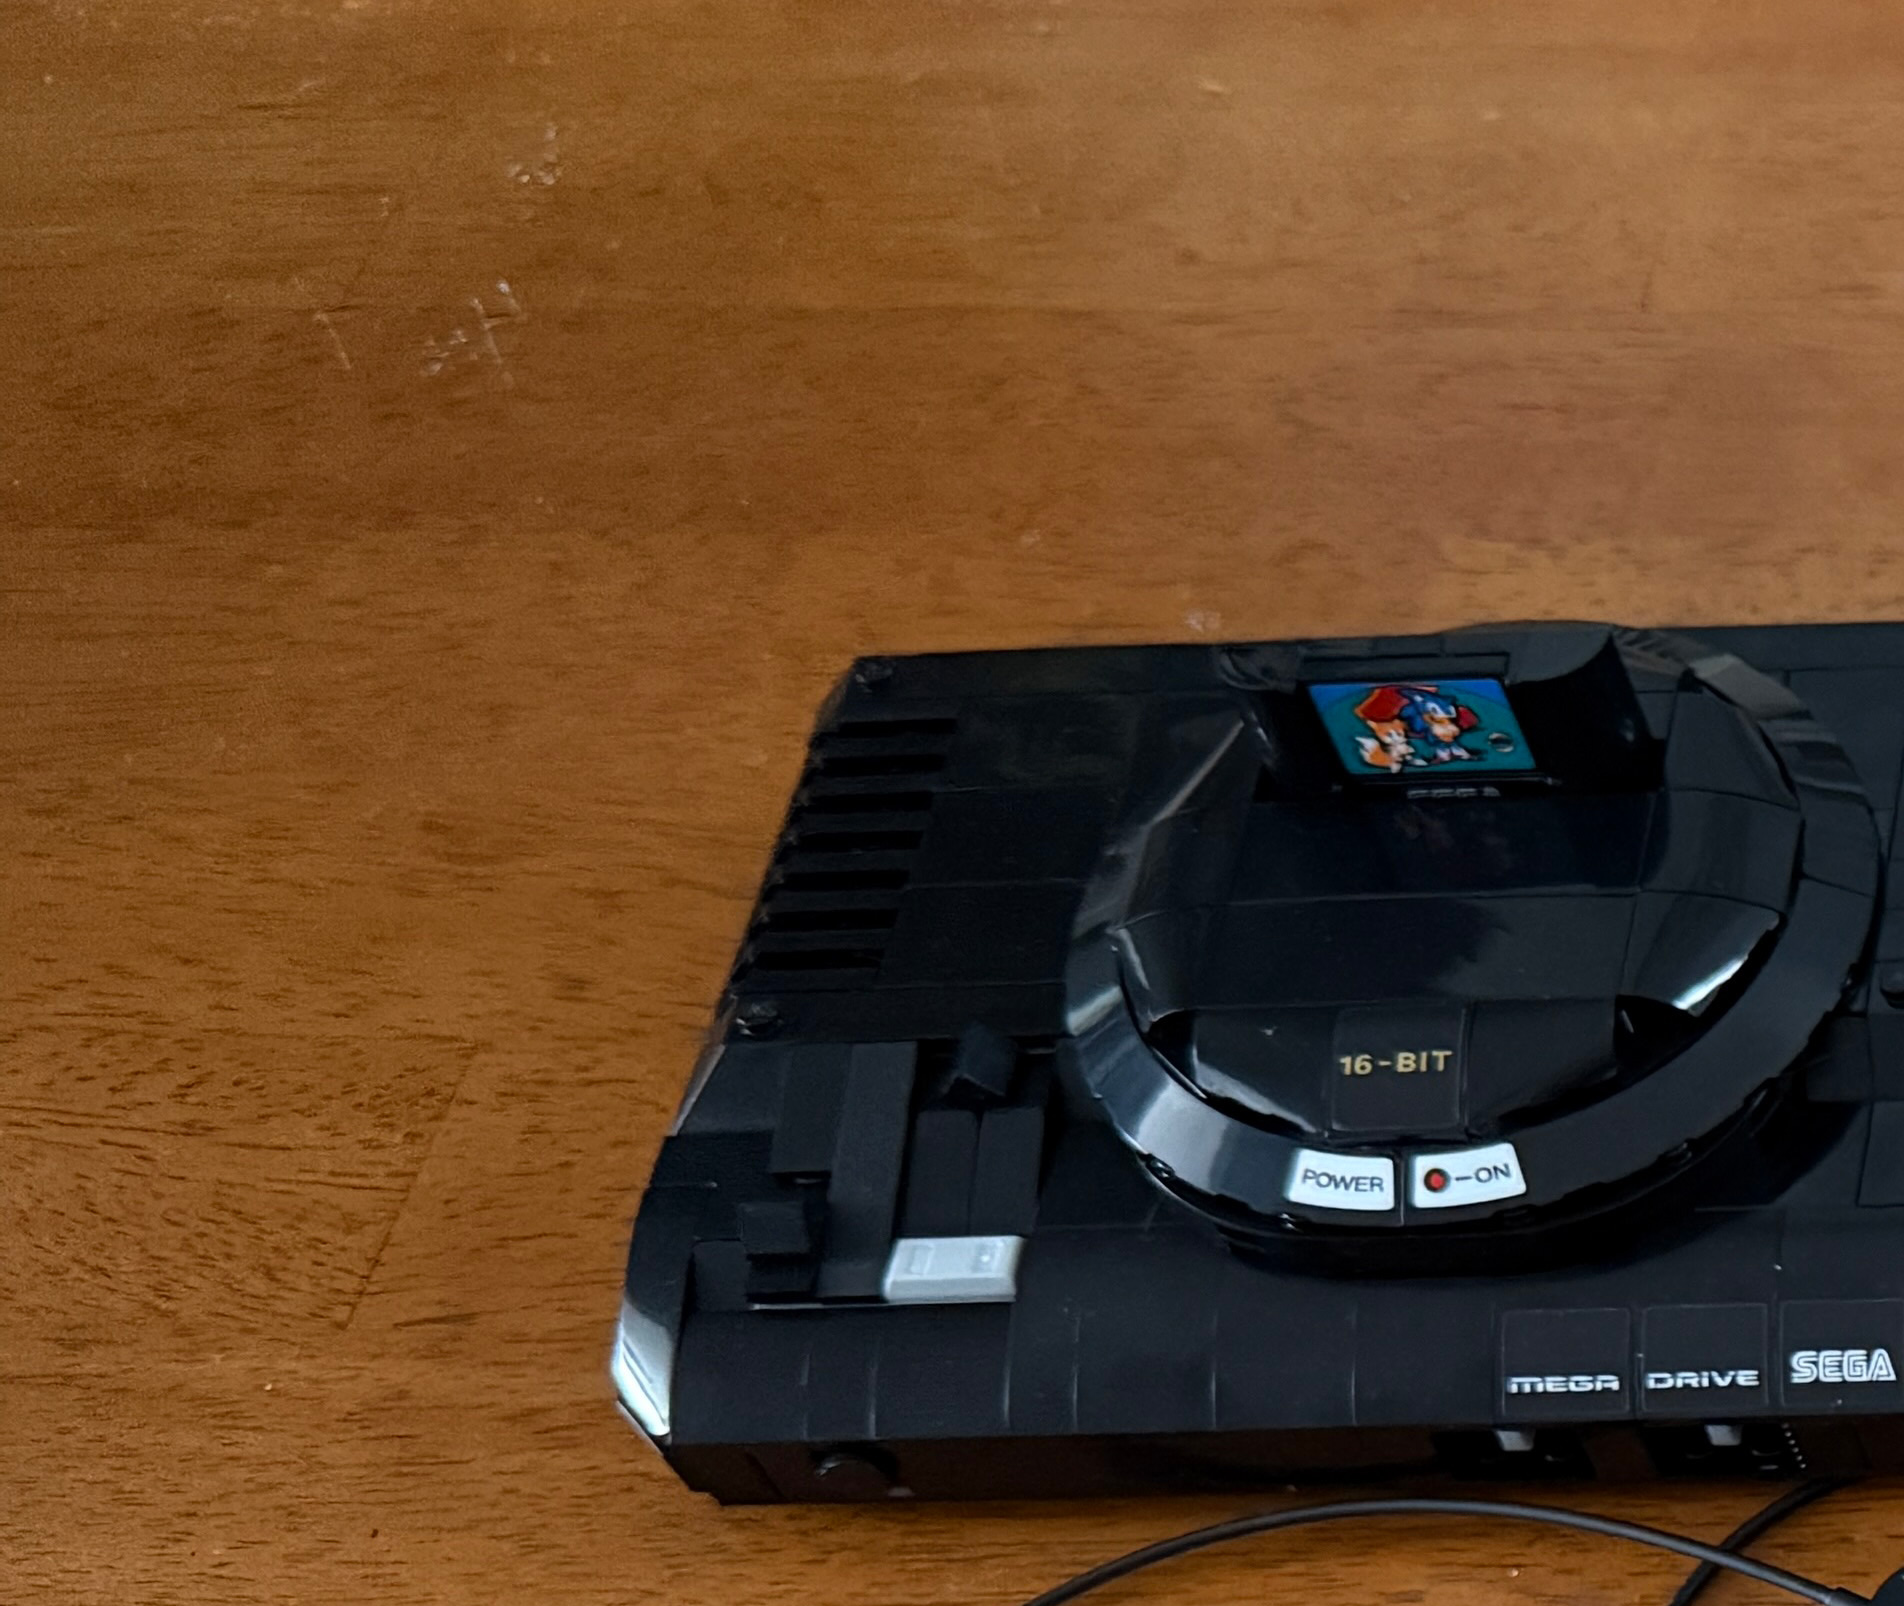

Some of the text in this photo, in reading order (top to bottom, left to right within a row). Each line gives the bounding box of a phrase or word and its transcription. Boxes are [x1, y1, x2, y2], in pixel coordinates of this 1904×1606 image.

[1339, 1050, 1453, 1076] 16-BIT
[1302, 1164, 1512, 1193] POWER ON
[1506, 1348, 1897, 1394] MEGA DRIVE SEGA
